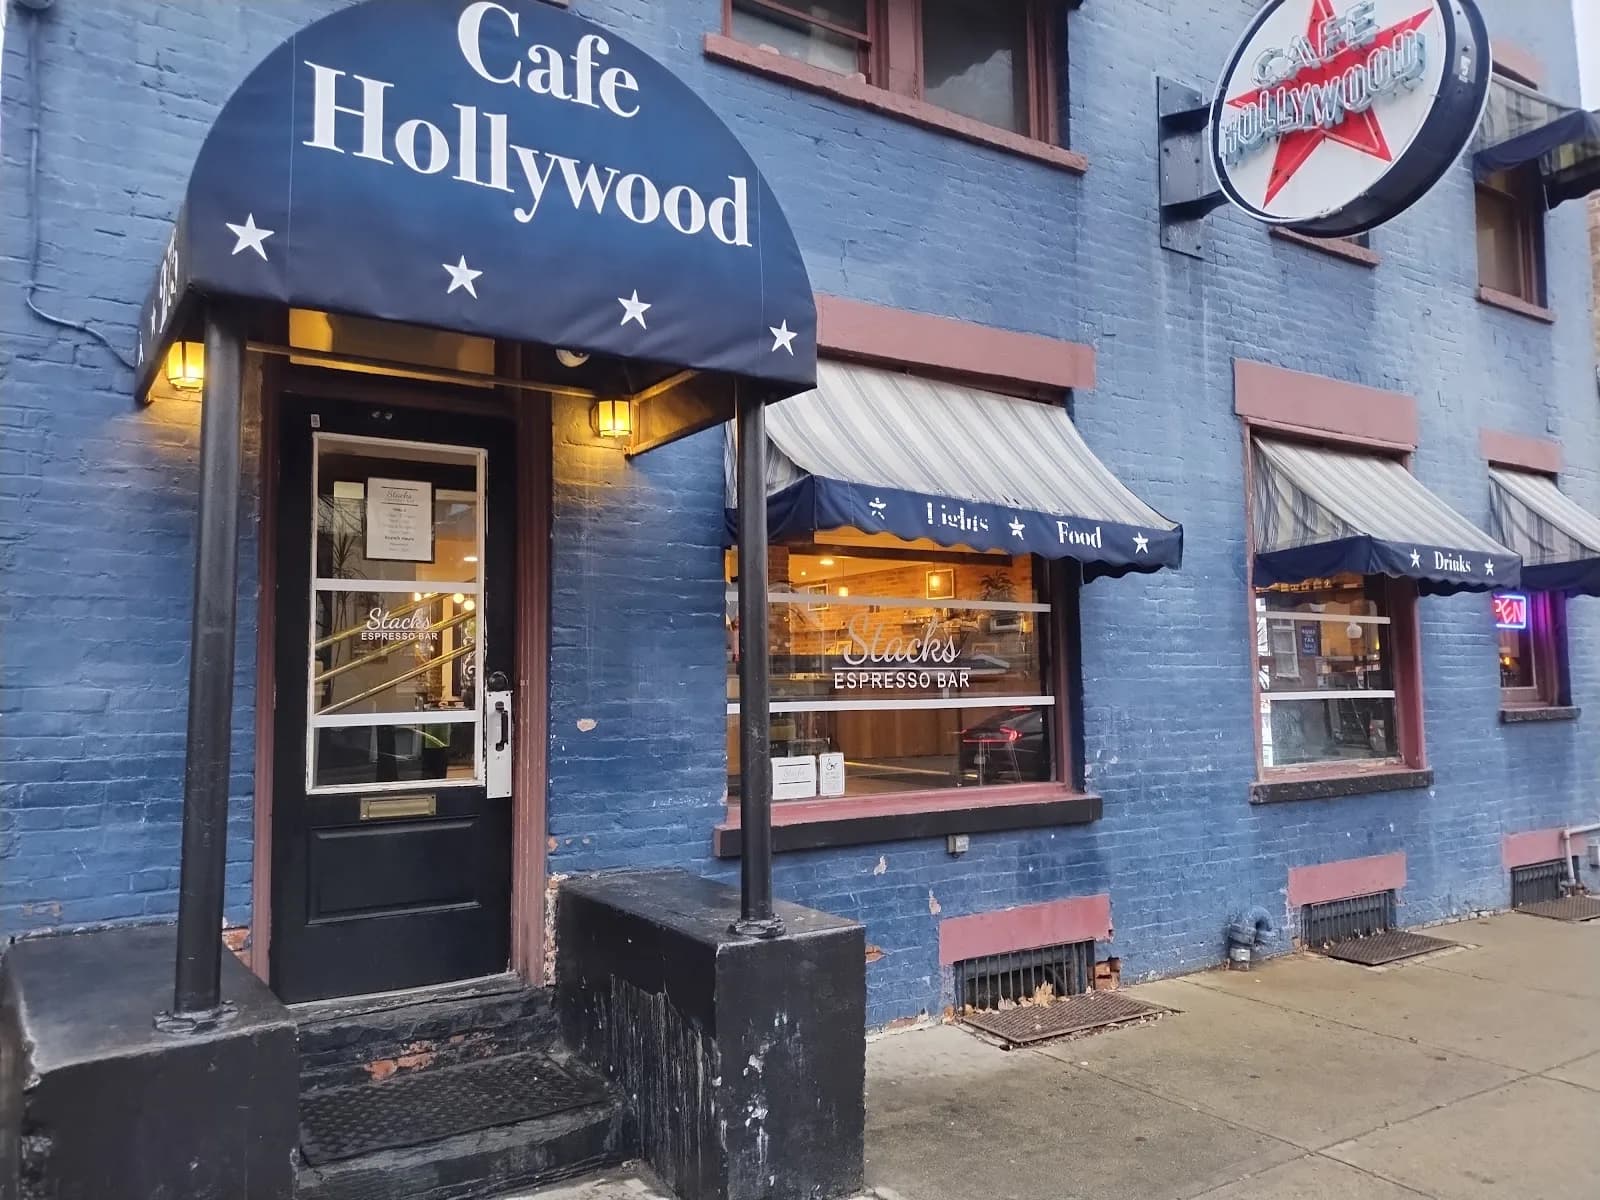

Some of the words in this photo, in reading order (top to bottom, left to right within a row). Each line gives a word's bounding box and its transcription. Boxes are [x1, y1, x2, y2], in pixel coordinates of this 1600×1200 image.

[457, 1, 641, 119] Cafe
[1251, 1, 1377, 87] CAFE
[1219, 29, 1426, 165] HOLLYWOOD
[302, 60, 753, 248] Hollywood
[1055, 520, 1102, 549] Food
[1433, 550, 1471, 573] Drinks
[361, 632, 415, 641] ESPRESSO
[418, 632, 438, 641] BAR
[366, 607, 430, 630] Stacks
[843, 611, 961, 665] Stacks
[834, 672, 931, 689] ESPRESSO
[937, 672, 970, 688] BAR
